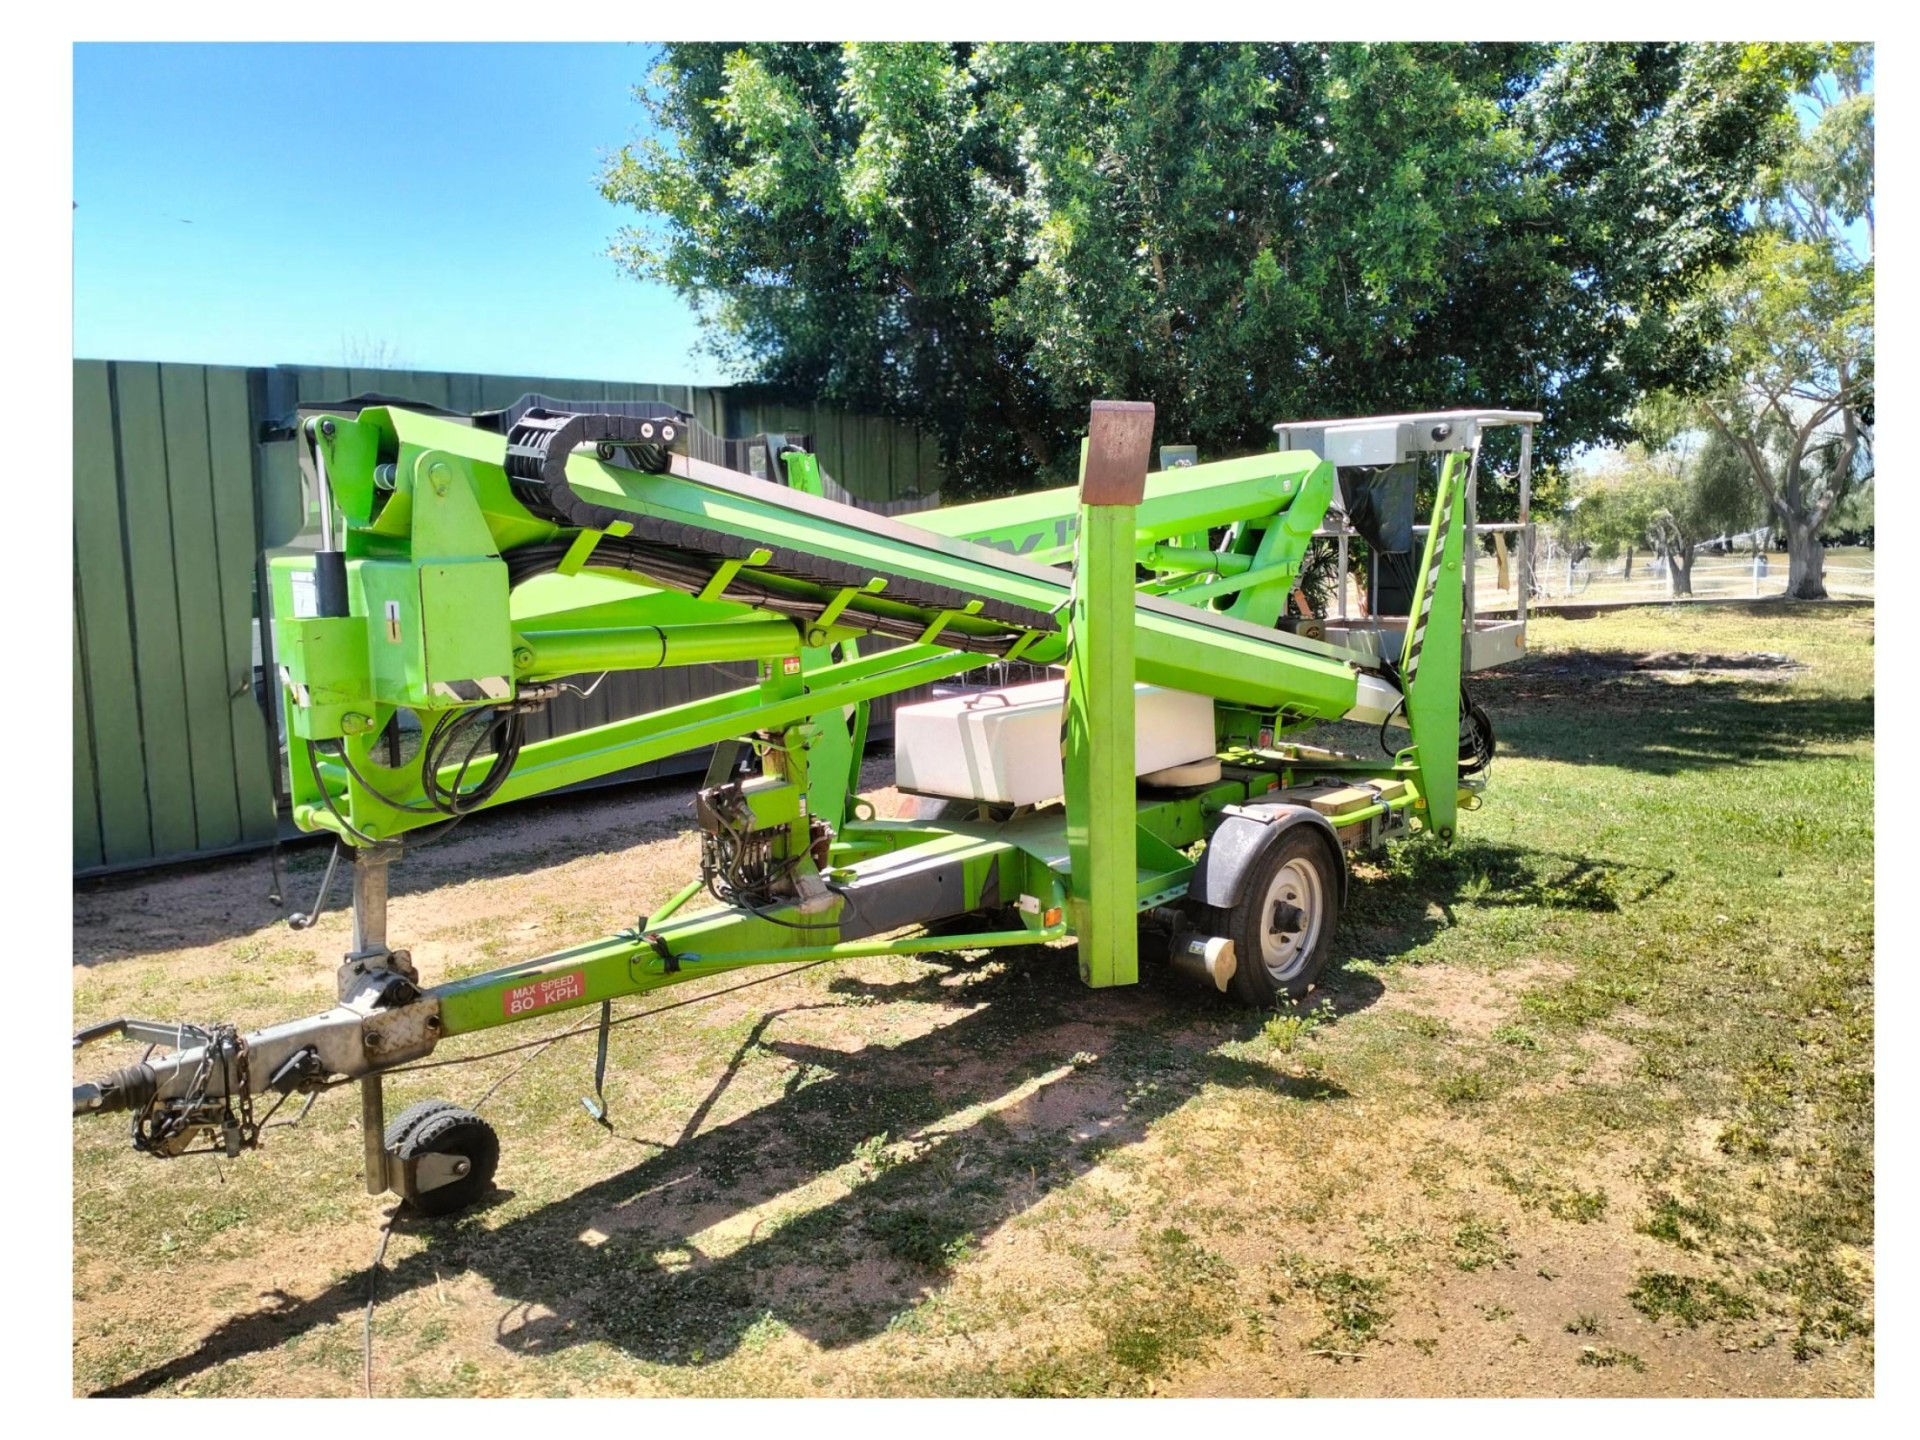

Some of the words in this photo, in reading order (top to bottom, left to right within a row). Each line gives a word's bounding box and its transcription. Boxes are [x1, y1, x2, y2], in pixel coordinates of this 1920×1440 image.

[511, 997, 534, 1014] 80
[544, 984, 578, 1004] KPH
[513, 985, 536, 999] MAX
[540, 975, 574, 992] SPEED
